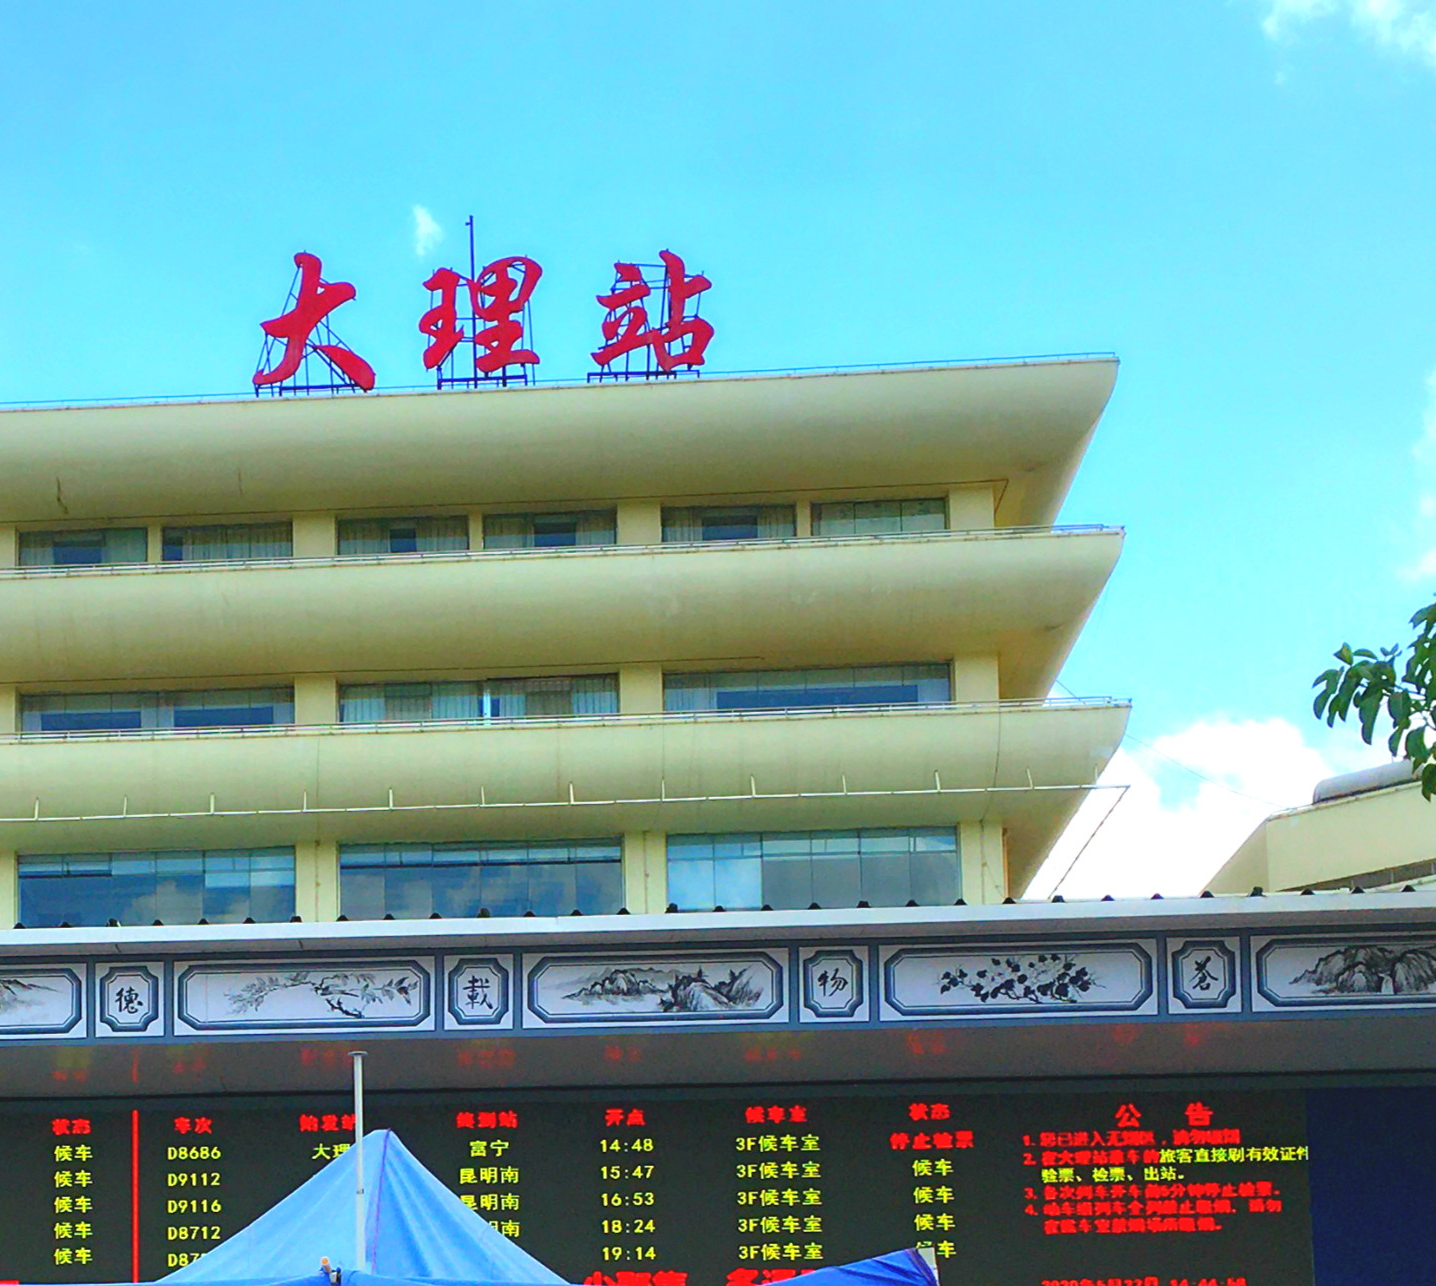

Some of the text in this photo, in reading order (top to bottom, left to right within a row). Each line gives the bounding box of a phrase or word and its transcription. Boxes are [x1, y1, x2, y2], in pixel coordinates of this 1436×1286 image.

[253, 250, 715, 392] 大理站
[818, 969, 849, 998] 物
[115, 985, 145, 1014] 德
[174, 1116, 213, 1135] 车次
[605, 1108, 645, 1127] 开点
[1115, 1102, 1214, 1130] 公告
[53, 1144, 93, 1162] 候车
[167, 1146, 222, 1161] D8686
[469, 1139, 509, 1158] 富宁
[600, 1138, 654, 1153] 14:48
[735, 1133, 820, 1153] 3F候车室
[53, 1169, 93, 1188] 候车
[167, 1158, 954, 1187] D9112 昆明南 15:47 3F候车室 候车
[53, 1195, 93, 1213] 候车
[167, 1185, 955, 1214] D9116 昆明南 16:53 3F候车室 候车
[53, 1220, 93, 1239] 候车
[167, 1212, 956, 1241] D8712 18:24 3F候车室 候车
[53, 1246, 93, 1265] 候车
[167, 1252, 207, 1268] D87
[602, 1246, 657, 1261] 19:14
[738, 1241, 823, 1261] 3F候车室
